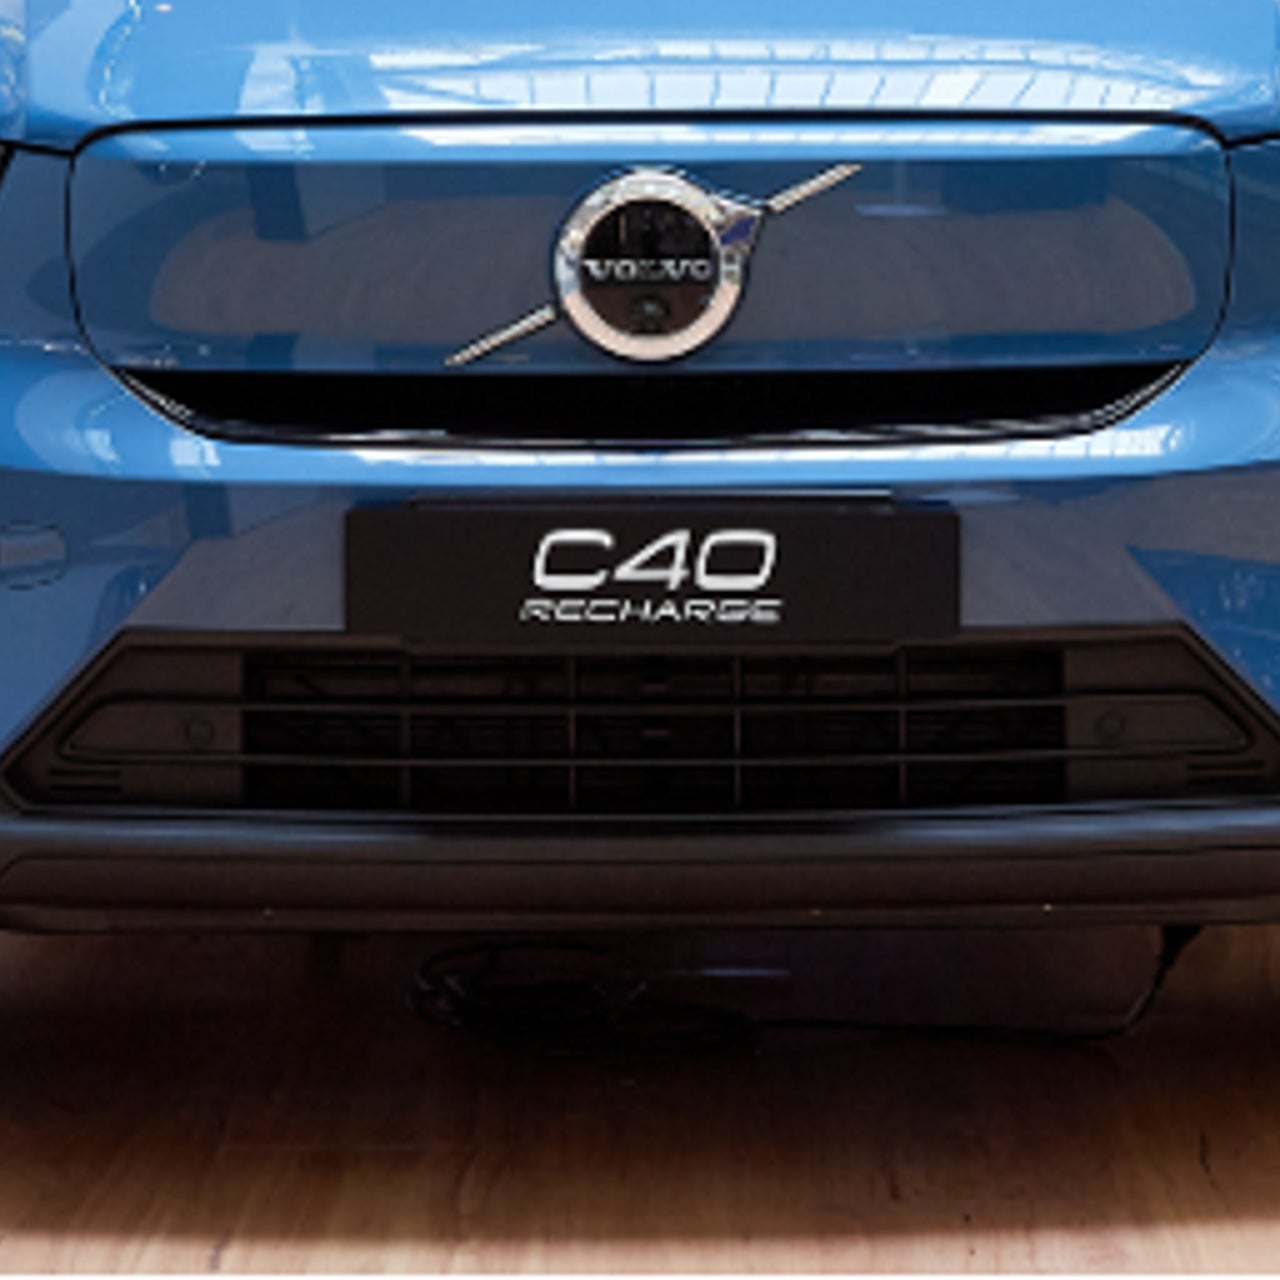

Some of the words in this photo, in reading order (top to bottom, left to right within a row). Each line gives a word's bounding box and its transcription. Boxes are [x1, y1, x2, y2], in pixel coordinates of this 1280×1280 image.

[582, 258, 714, 282] VOLVO
[532, 528, 778, 592] C40
[519, 598, 784, 623] RECHARGE
